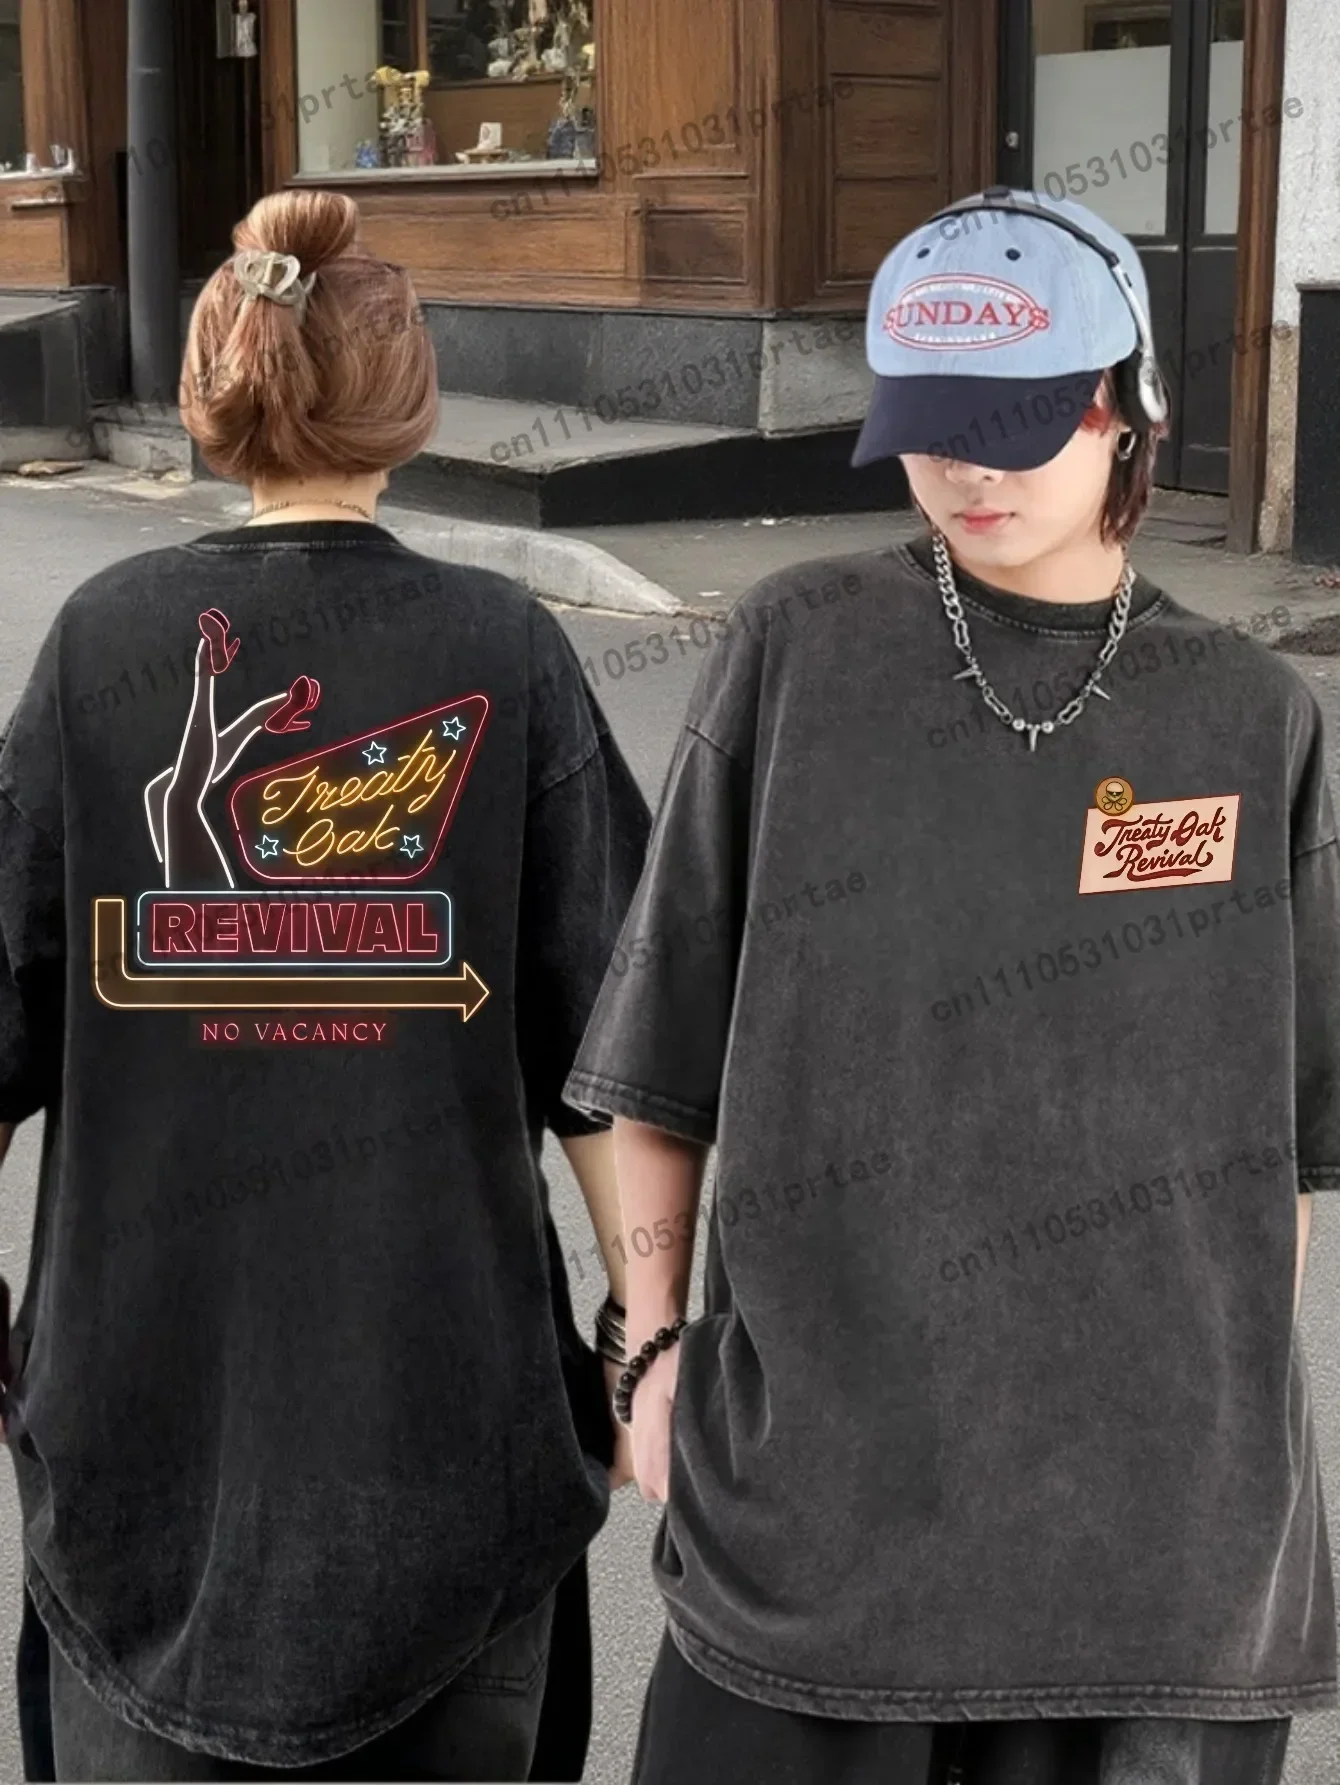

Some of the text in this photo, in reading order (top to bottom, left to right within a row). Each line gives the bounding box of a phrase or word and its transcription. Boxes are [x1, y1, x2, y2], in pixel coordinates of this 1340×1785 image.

[882, 300, 1050, 331] SUNDAYS
[262, 729, 456, 825] Treaty
[282, 804, 401, 867] Oak
[1094, 806, 1227, 857] Treaty Oak
[1102, 839, 1214, 882] Revival
[152, 902, 438, 953] REVIVAL
[202, 1022, 388, 1041] NO VACANCY
